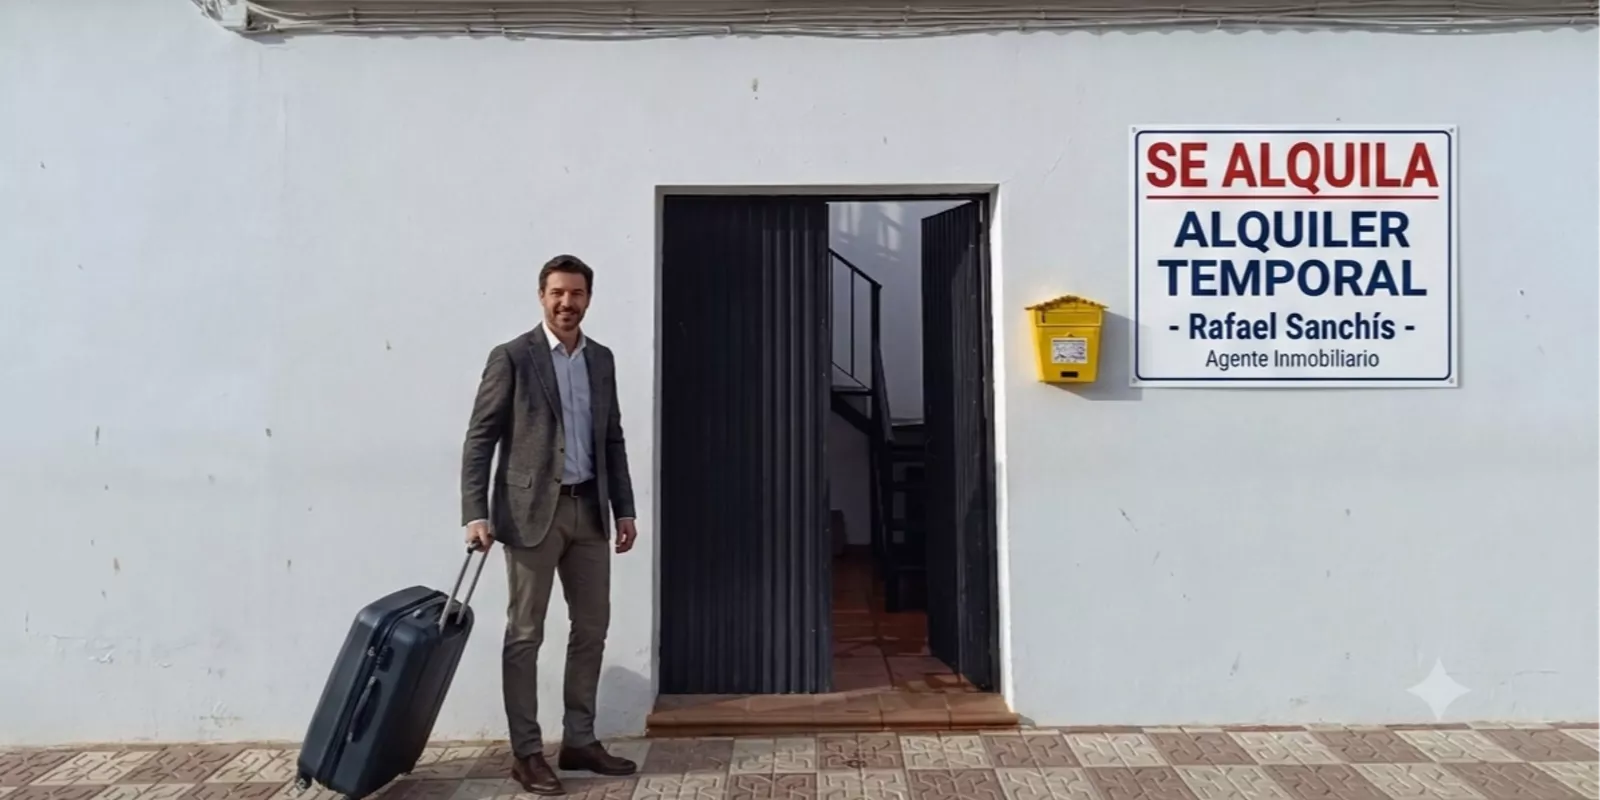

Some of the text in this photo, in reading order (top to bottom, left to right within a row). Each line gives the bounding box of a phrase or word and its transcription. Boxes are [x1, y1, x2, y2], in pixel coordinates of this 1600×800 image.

[1146, 142, 1439, 195] SE ALQUILA
[1173, 211, 1410, 253] ALQUILER
[1157, 259, 1428, 296] TEMPORAL
[1189, 312, 1277, 340] Rafael
[1286, 312, 1396, 340] Sanchís
[1205, 349, 1380, 371] Agente Inmobiliario
